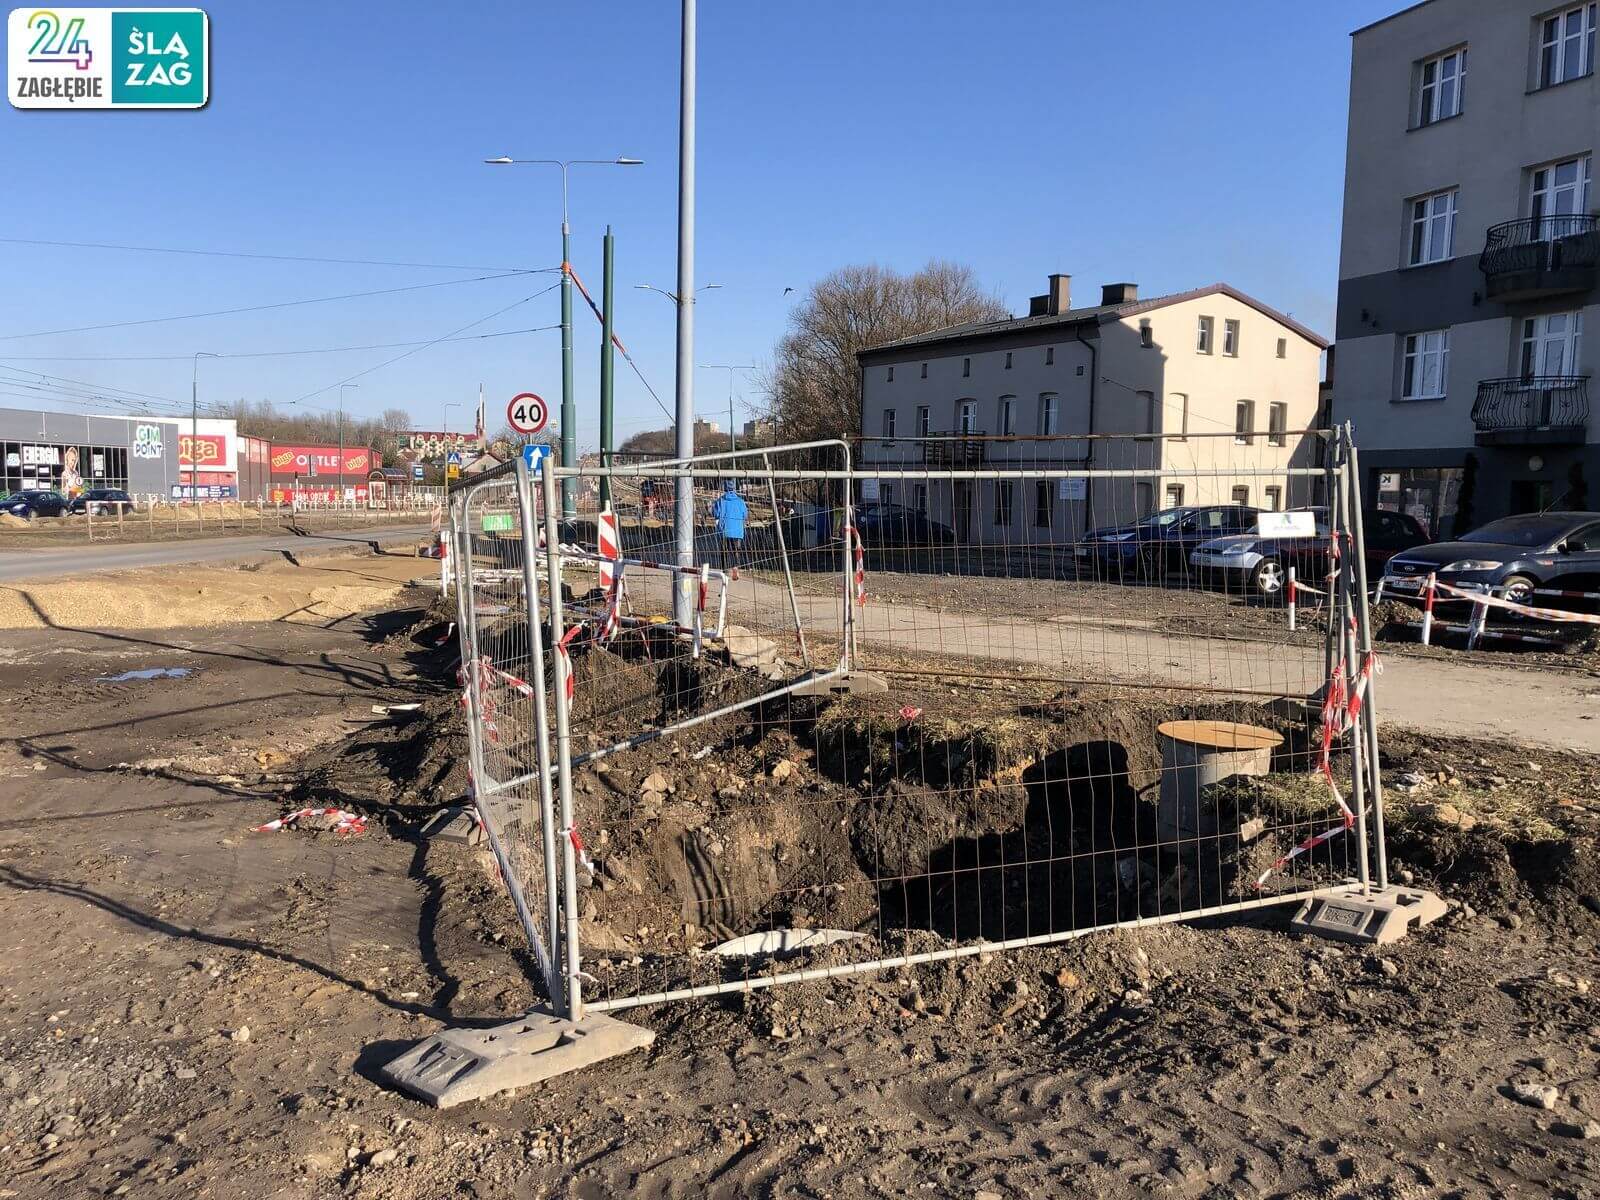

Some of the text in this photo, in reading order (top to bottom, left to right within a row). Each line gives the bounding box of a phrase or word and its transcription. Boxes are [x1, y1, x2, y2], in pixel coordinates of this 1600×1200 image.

[514, 404, 541, 423] 40
[23, 446, 59, 464] ENERGIA
[296, 455, 344, 466] OTLE
